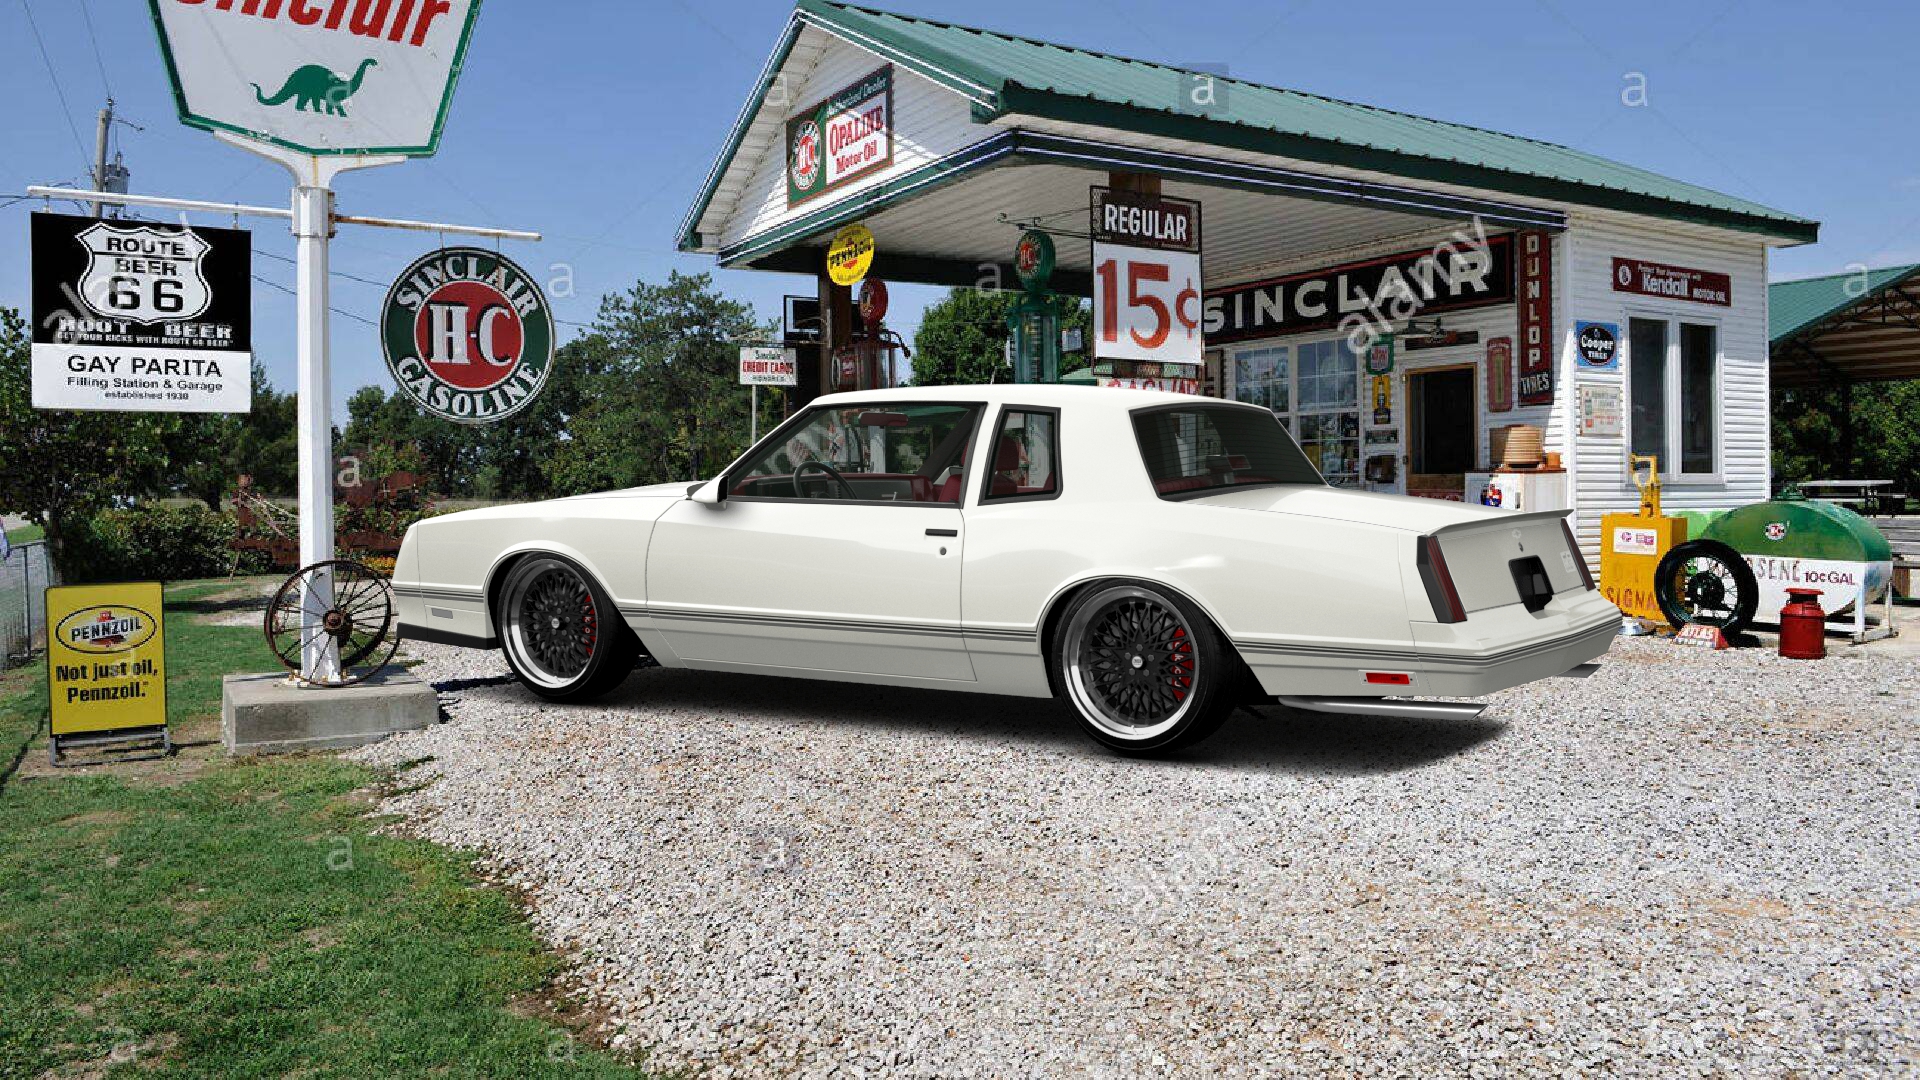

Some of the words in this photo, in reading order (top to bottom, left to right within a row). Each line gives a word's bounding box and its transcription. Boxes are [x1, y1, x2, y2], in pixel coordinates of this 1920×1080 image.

[830, 106, 884, 156] OPALINE
[836, 152, 863, 174] Motor
[864, 139, 877, 161] Oil
[1104, 203, 1187, 241] REGULAR
[106, 237, 186, 256] ROUTE
[114, 258, 177, 276] BEER
[108, 275, 184, 313] 66
[396, 256, 539, 317] SINCLAIR
[1203, 249, 1490, 332] SINCLAIR
[1643, 272, 1689, 296] Kendall
[1526, 234, 1541, 368] DUNLOP
[164, 321, 233, 339] BEER
[428, 302, 513, 367] H-C
[1581, 335, 1614, 351] Cooper
[67, 354, 121, 374] GAY
[131, 356, 222, 377] PARITA
[742, 361, 768, 373] CREDIT
[770, 361, 794, 374] CARDS
[67, 376, 108, 390] Filling
[113, 377, 159, 389] Station
[163, 378, 172, 389] &
[177, 380, 223, 393] Garage
[104, 390, 163, 400] established
[397, 356, 542, 417] GASOLINE
[1606, 586, 1656, 609] SIGNA
[71, 617, 143, 642] PENNZOIL
[56, 664, 87, 681] Not
[92, 661, 127, 681] just
